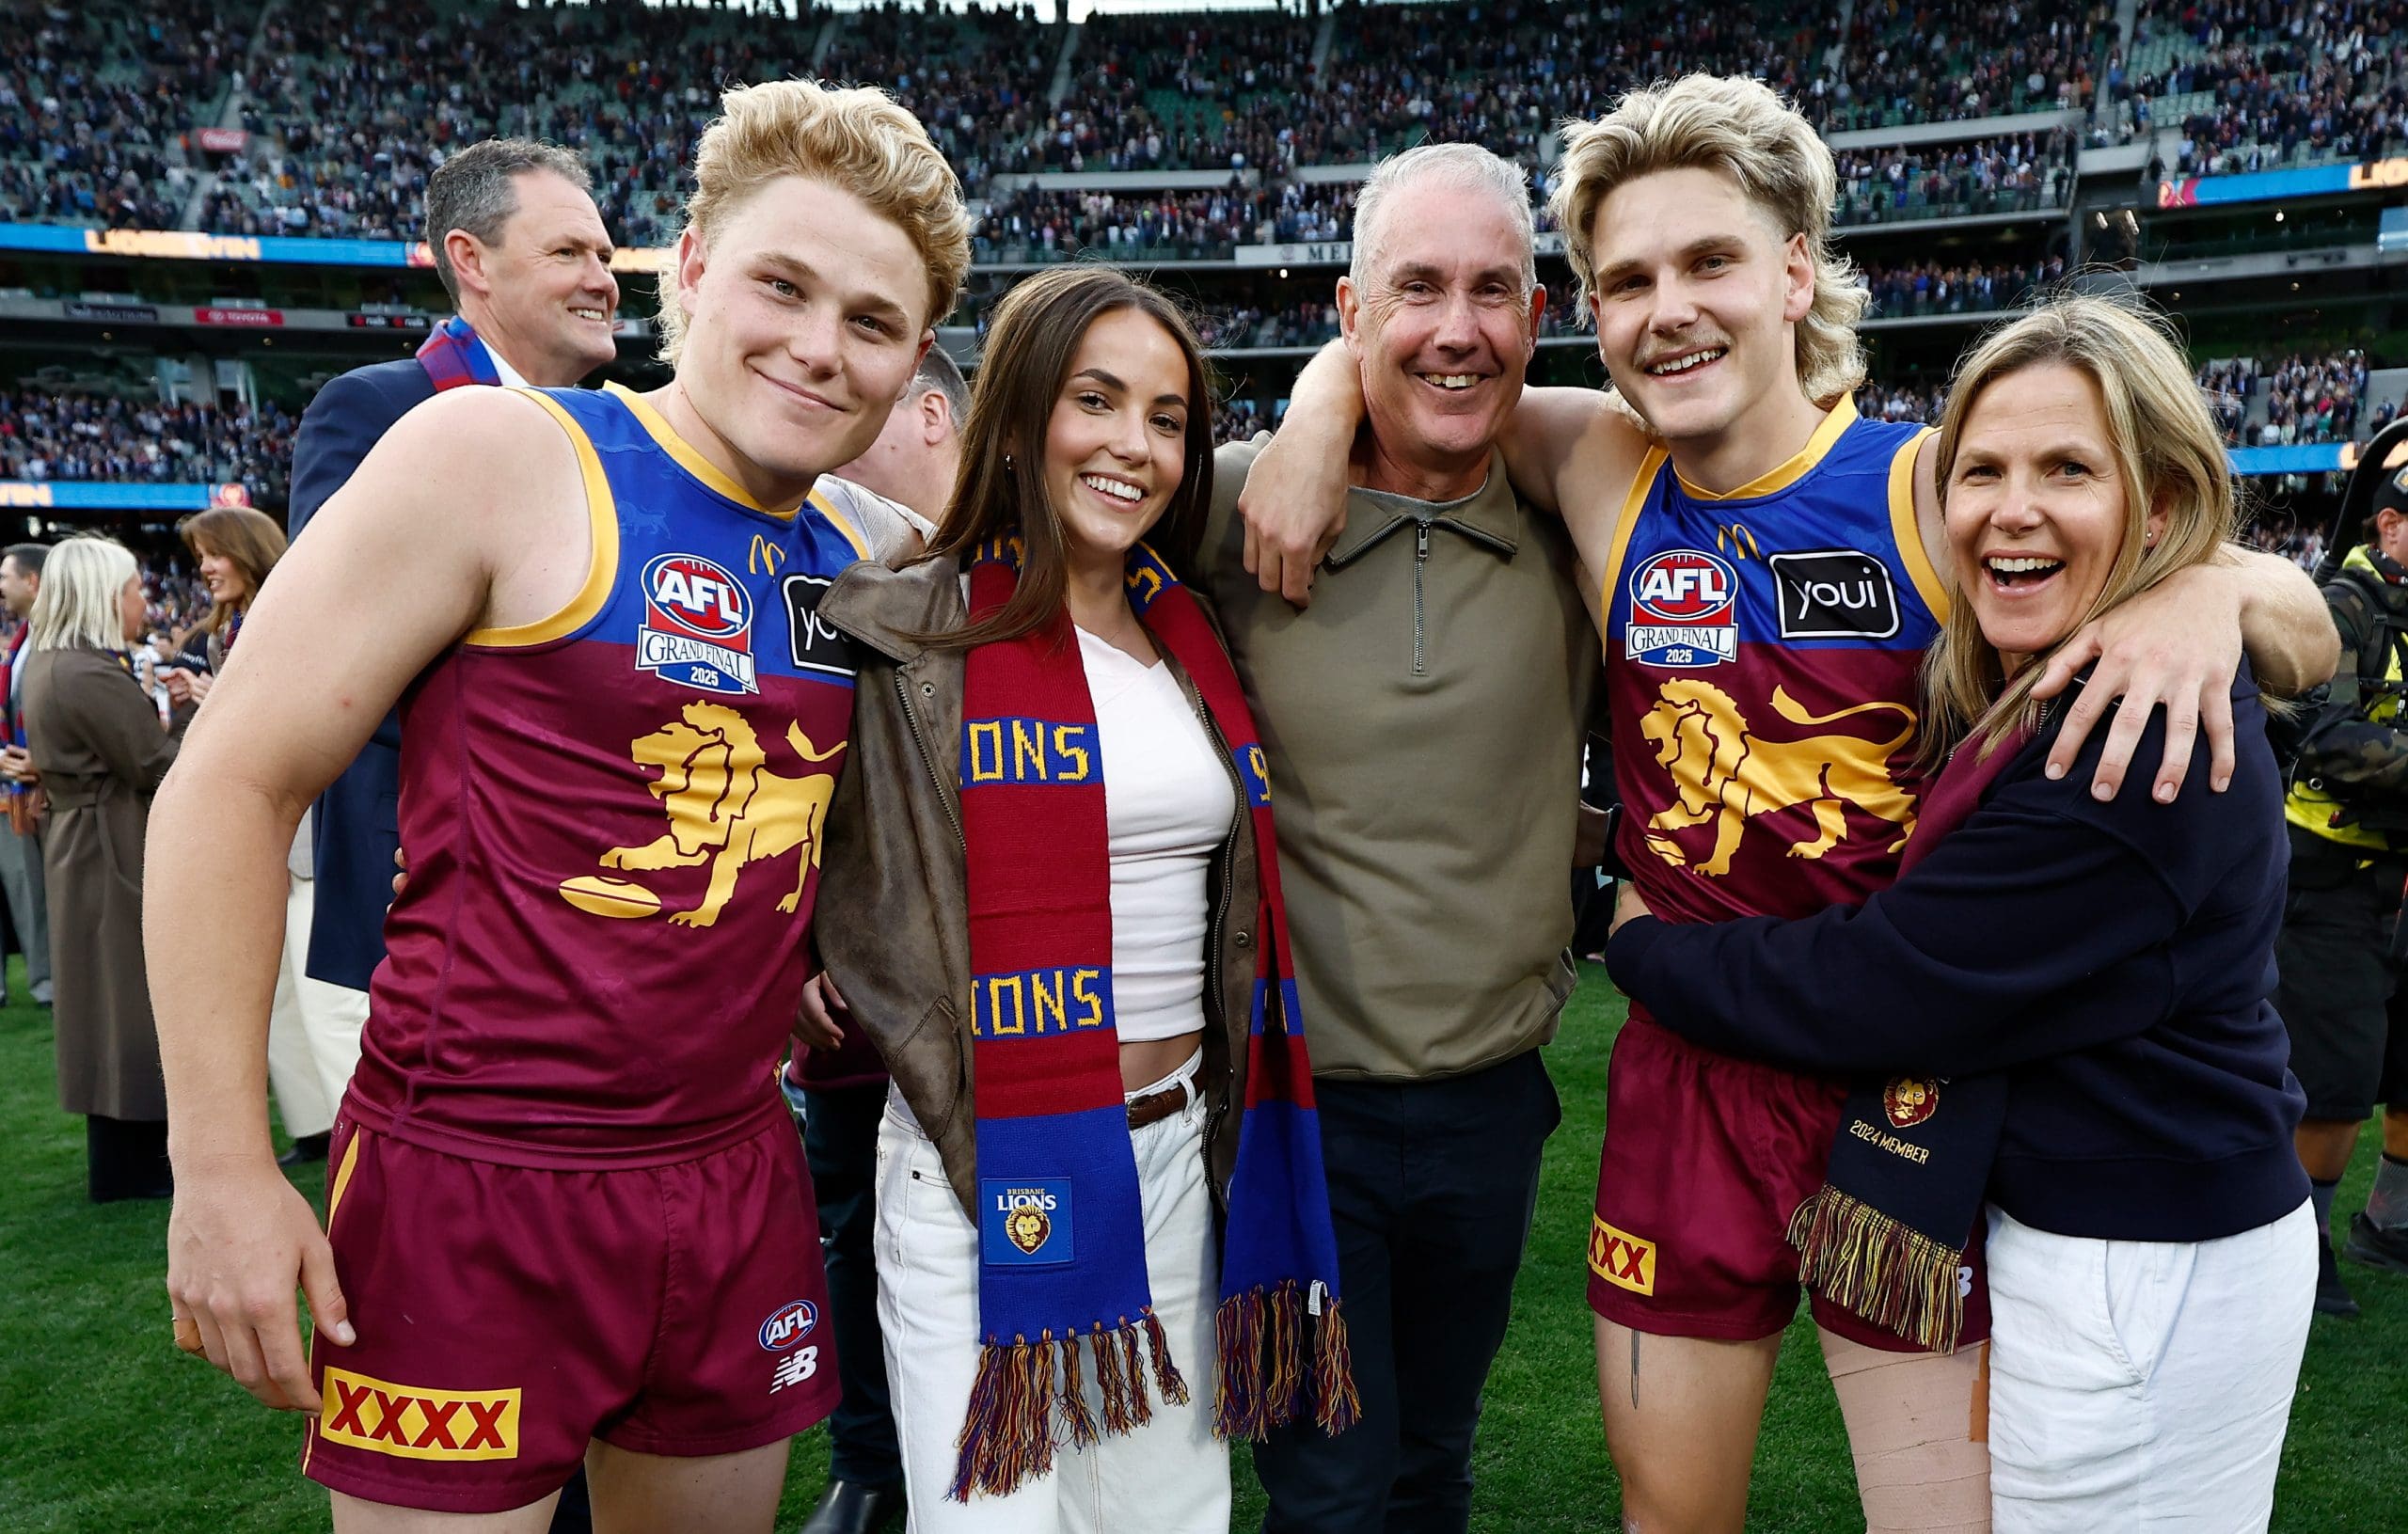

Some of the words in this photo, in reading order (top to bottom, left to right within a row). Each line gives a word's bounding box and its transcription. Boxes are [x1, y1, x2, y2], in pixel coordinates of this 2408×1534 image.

[655, 567, 743, 625] AFL
[1640, 567, 1727, 602] AFL
[1790, 566, 1877, 620] youi
[646, 634, 705, 663] GRAND
[705, 646, 752, 684] FINAL
[1632, 626, 1679, 651] GRAND
[1682, 627, 1732, 655] FINAL
[1665, 649, 1693, 663] 2025
[690, 666, 719, 687] 2025
[1849, 1119, 1882, 1145] 2024
[1878, 1132, 1929, 1165] MEMBER
[997, 1194, 1057, 1211] LIONS
[767, 1307, 814, 1346] AFL
[328, 1378, 511, 1450] XXXX
